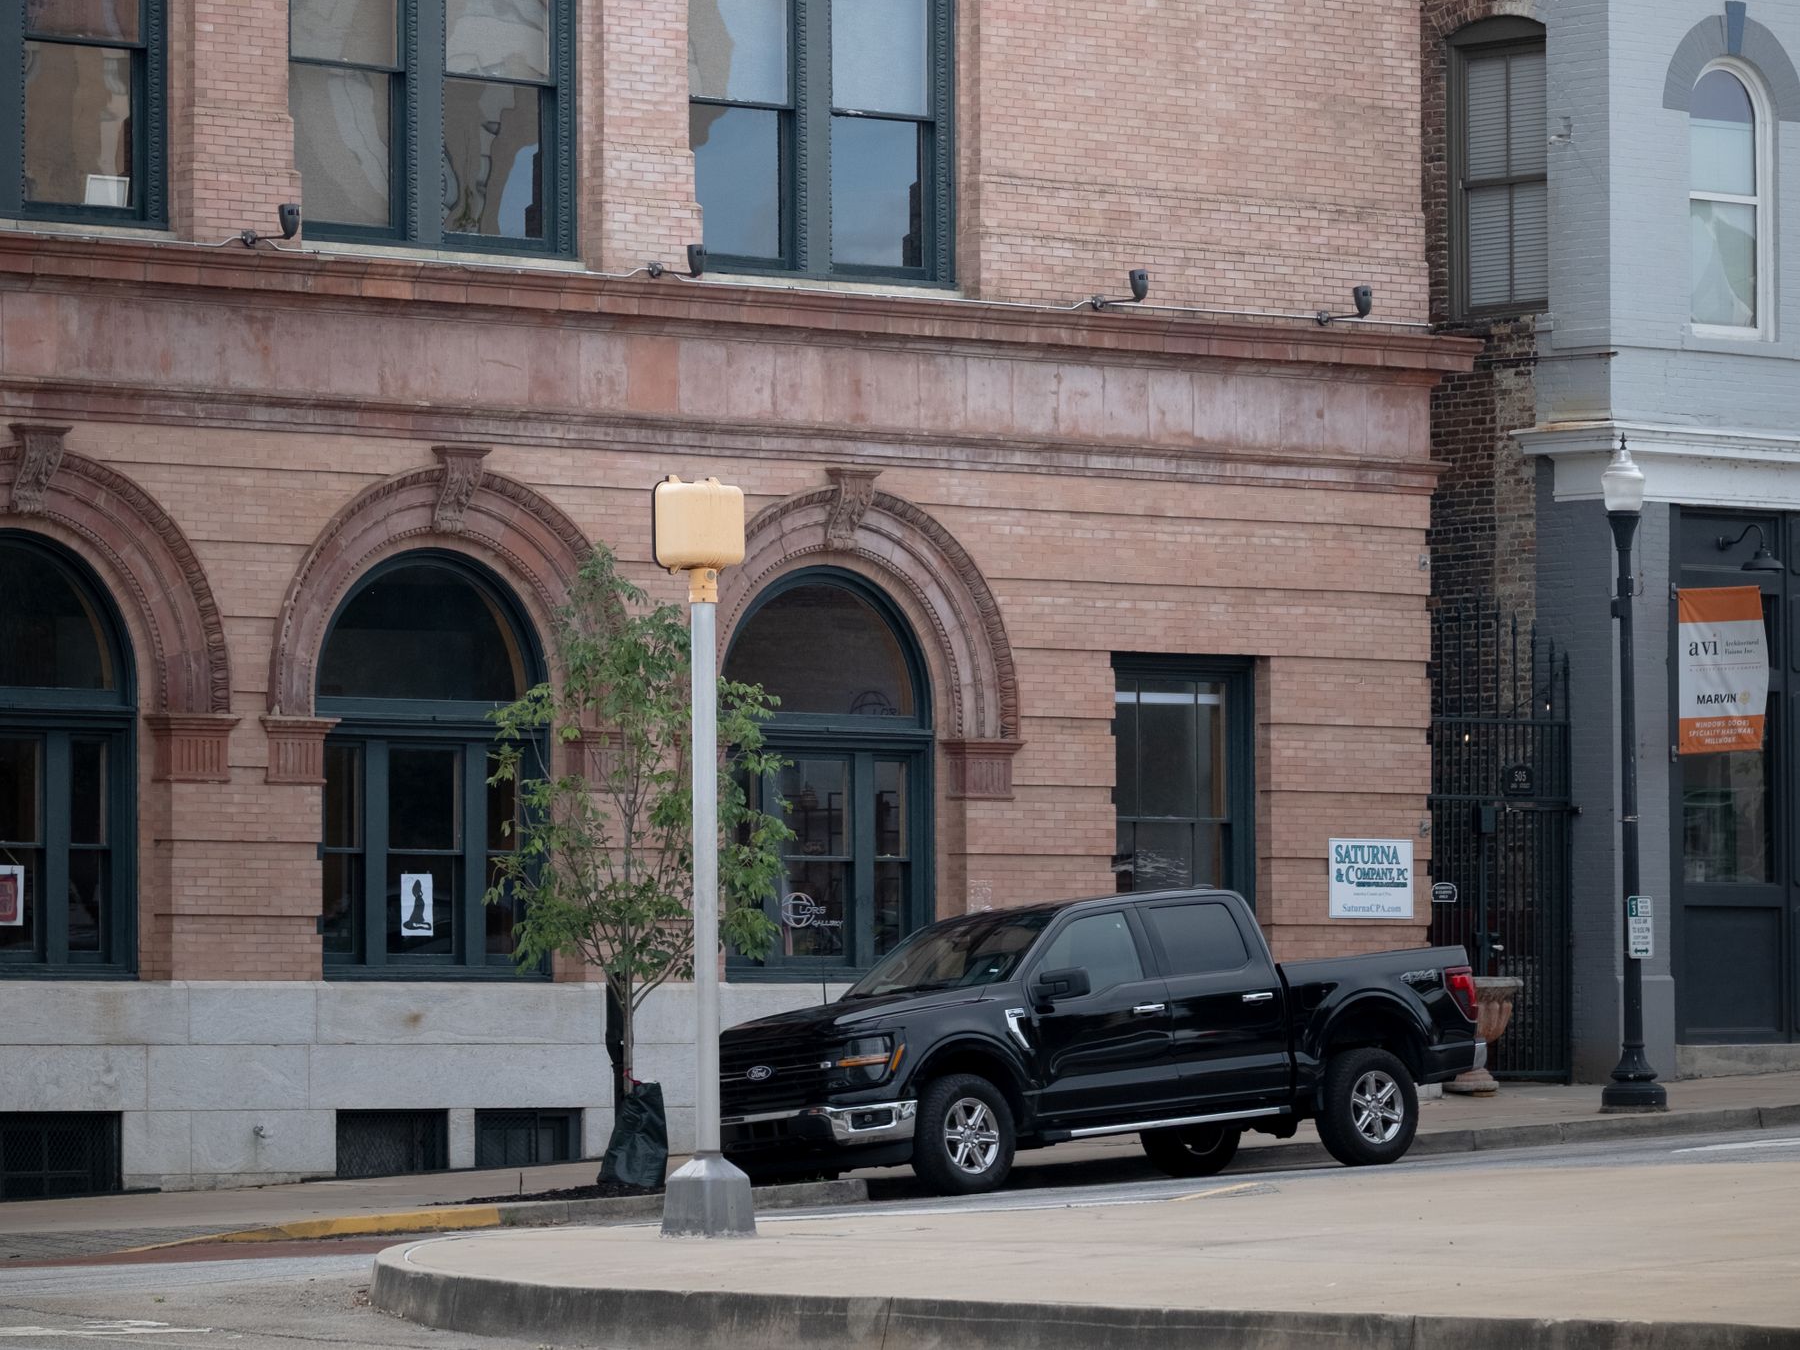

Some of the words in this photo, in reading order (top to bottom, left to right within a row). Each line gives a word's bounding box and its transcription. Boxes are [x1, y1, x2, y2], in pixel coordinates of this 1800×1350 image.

[1689, 633, 1719, 656] avi
[1697, 693, 1737, 705] MARVIN
[1514, 770, 1527, 782] 505
[1335, 844, 1400, 865] SATURNA
[1335, 868, 1344, 883] &
[1396, 868, 1408, 881] PC
[1342, 903, 1402, 913] SaturnaCPA.com
[751, 1068, 767, 1078] Ford
